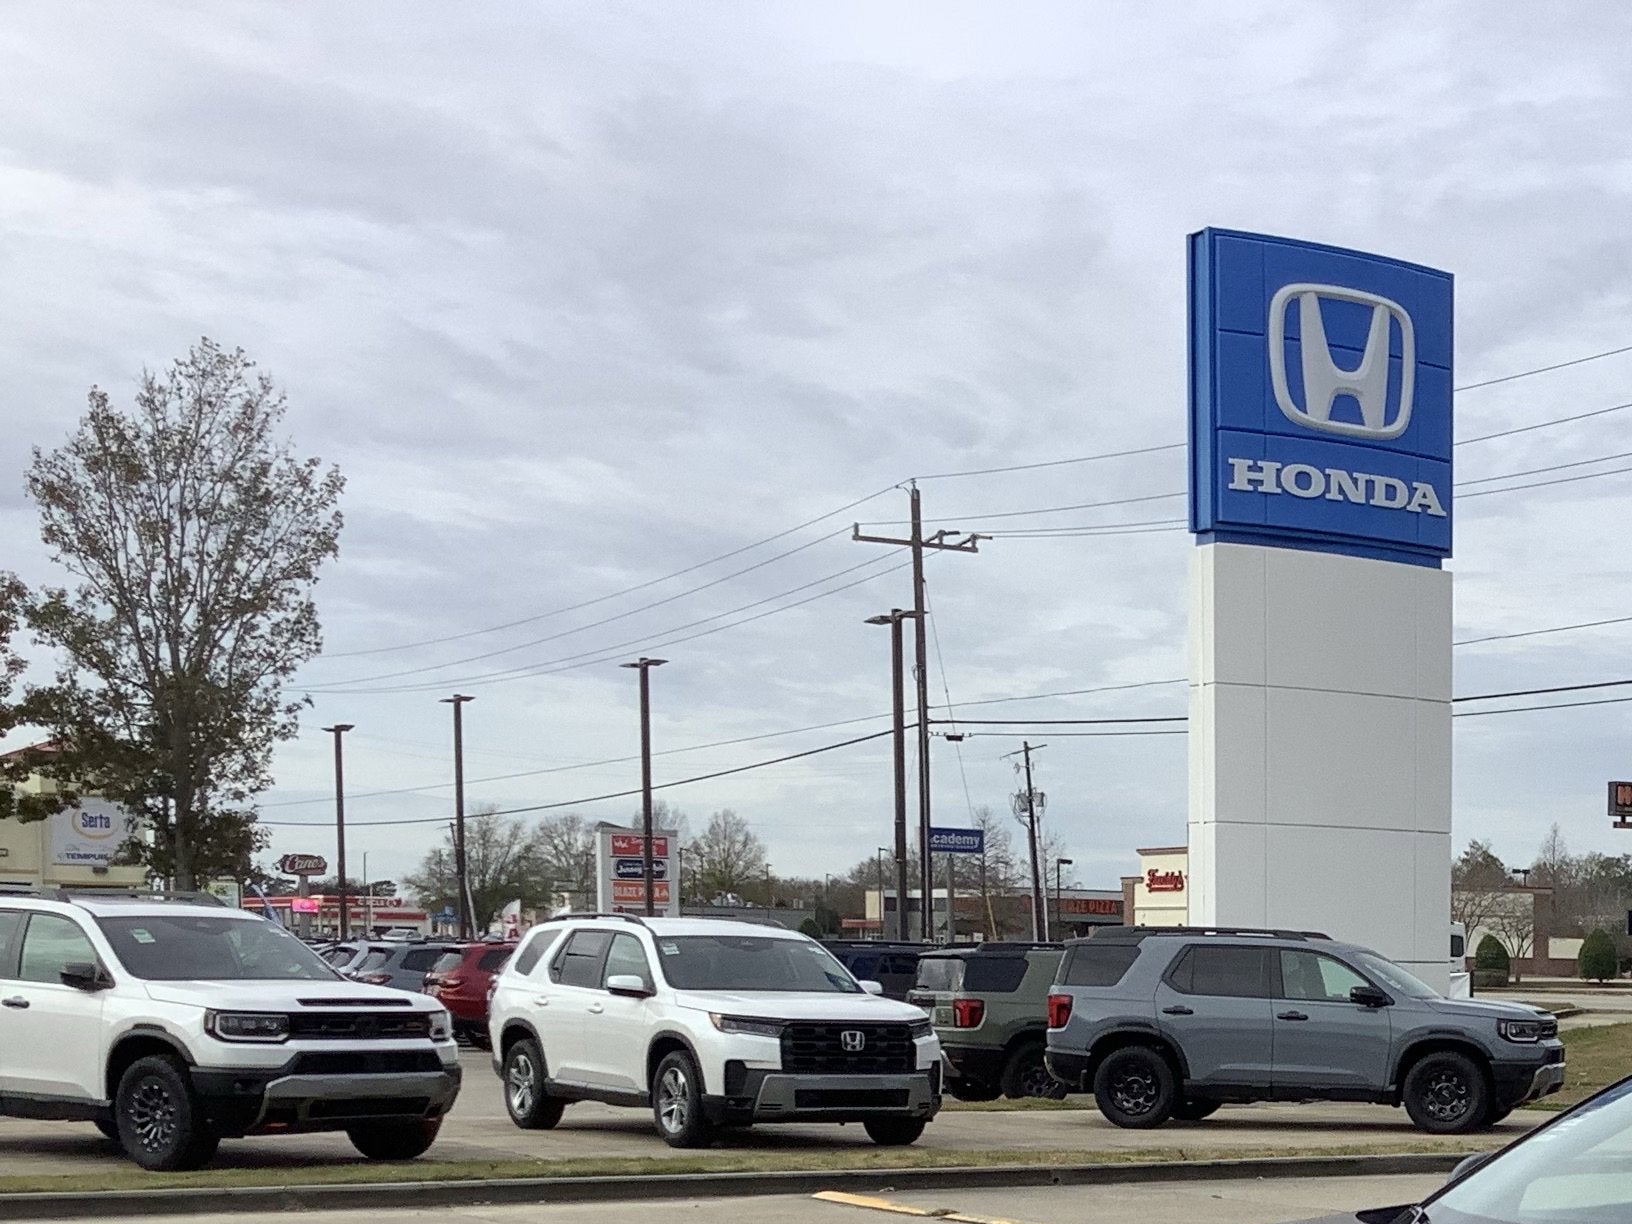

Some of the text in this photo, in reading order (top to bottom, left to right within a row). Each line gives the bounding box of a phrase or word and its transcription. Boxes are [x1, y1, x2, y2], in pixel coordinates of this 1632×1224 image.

[1228, 457, 1447, 517] HONDA
[81, 812, 111, 829] Serta
[1089, 899, 1118, 914] PIZZA
